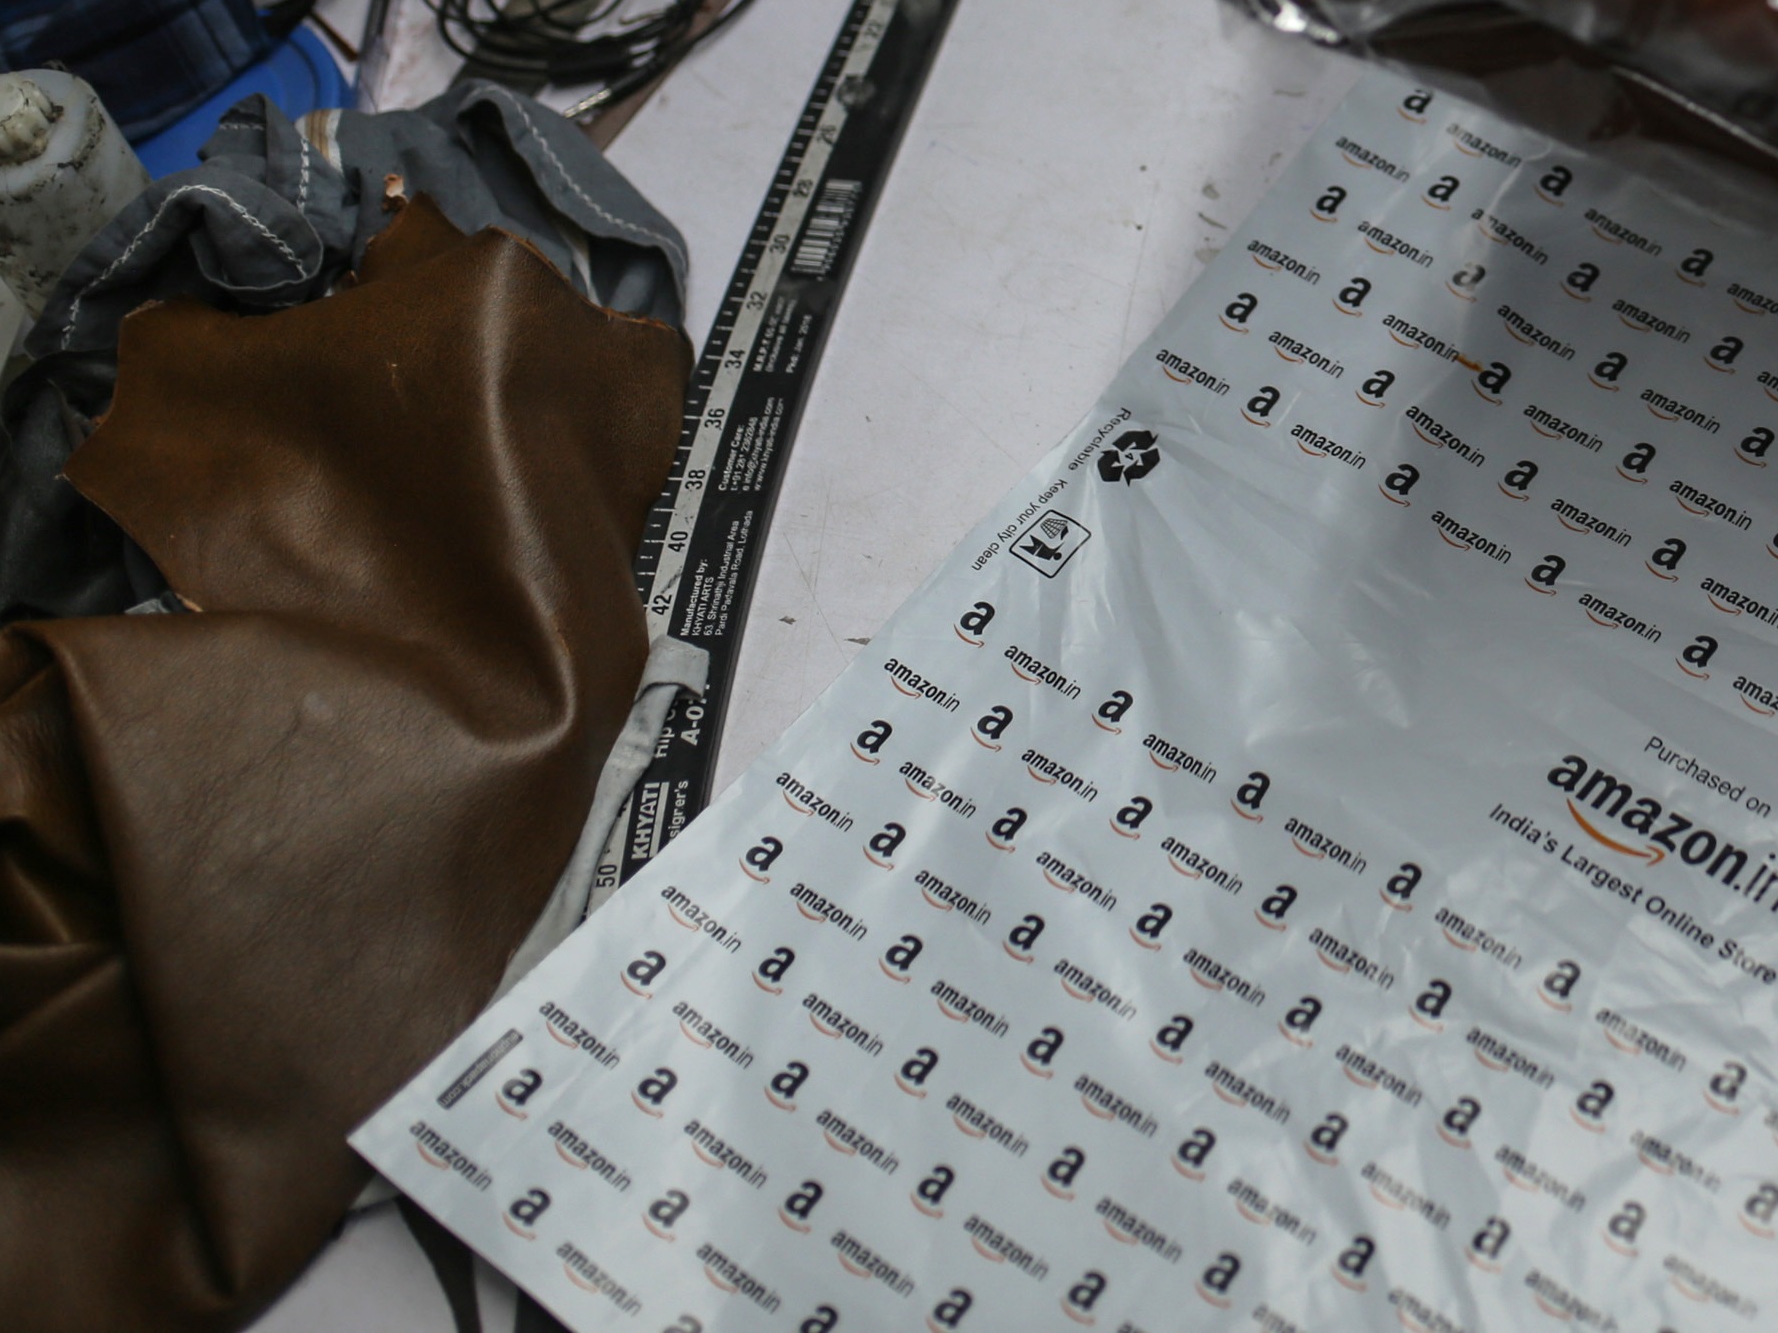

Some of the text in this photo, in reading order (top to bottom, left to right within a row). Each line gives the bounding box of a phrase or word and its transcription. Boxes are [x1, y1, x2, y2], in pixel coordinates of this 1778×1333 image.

[1335, 137, 1410, 181] amazon.in
[793, 178, 814, 198] 28
[1427, 175, 1460, 203] a
[769, 233, 790, 254] 30
[1357, 221, 1433, 268] amazon.in
[1584, 208, 1662, 256] amazon.in
[1247, 240, 1320, 285] amazon.in
[746, 291, 768, 311] 32
[1225, 292, 1258, 324] a
[1612, 299, 1691, 343] amazon.in
[725, 349, 746, 370] 34
[1268, 331, 1344, 378] amazon.in
[1382, 314, 1459, 360] amazon.in
[1497, 305, 1575, 361] amazon.in
[1156, 349, 1230, 396] amazon.in
[1477, 361, 1512, 395] a
[704, 407, 725, 430] 36
[1405, 406, 1485, 467] amazon.in
[1523, 405, 1603, 452] amazon.in
[1640, 389, 1720, 434] amazon.in
[1068, 407, 1132, 471] Recyclable
[1290, 424, 1366, 469] amazon.in
[685, 469, 706, 492] 38
[718, 449, 736, 491] Customer
[1504, 460, 1539, 491] a
[971, 479, 1069, 572] Keep your city clean
[1550, 499, 1632, 547] amazon.in
[1669, 480, 1752, 531] amazon.in
[667, 530, 689, 553] 40
[718, 542, 734, 579] Industrial
[727, 521, 739, 540] Area
[1431, 511, 1511, 564] amazon.in
[1652, 538, 1687, 571] a
[650, 592, 674, 616] 42
[680, 560, 708, 636] Manufactured by:
[692, 577, 714, 636] KHYATI ARTS
[715, 613, 727, 635] Pardi
[960, 601, 995, 636] a
[1578, 593, 1662, 643] amazon.in
[884, 658, 960, 712] amazon.in
[1004, 645, 1081, 700] amazon.in
[1098, 690, 1133, 723] a
[1021, 749, 1098, 802] amazon.in
[1143, 734, 1217, 784] amazon.in
[1643, 736, 1772, 818] Purchased on
[670, 781, 688, 838] signer's
[776, 772, 853, 832] amazon.in
[899, 761, 976, 818] amazon.in
[632, 782, 660, 859] KHYATI
[992, 807, 1027, 841] a
[1284, 817, 1366, 874] amazon.in
[596, 863, 617, 889] 50
[746, 836, 783, 872] a
[1161, 837, 1243, 894] amazon.in
[915, 870, 991, 925] amazon.in
[1036, 852, 1117, 911] amazon.in
[1489, 803, 1778, 985] India's Largest Online Store
[661, 886, 741, 953] amazon.in
[790, 883, 867, 941] amazon.in
[1136, 903, 1173, 939] a
[1435, 908, 1522, 968] amazon.in
[1183, 948, 1265, 1006] amazon.in
[1309, 928, 1394, 989] amazon.in
[930, 980, 1009, 1037] amazon.in
[1053, 959, 1131, 1016] amazon.in
[539, 1002, 619, 1066] amazon.in
[673, 1002, 754, 1069] amazon.in
[802, 993, 883, 1056] amazon.in
[1285, 997, 1323, 1032] a
[770, 1061, 810, 1099] a
[1335, 1045, 1422, 1106] amazon.in
[1466, 1028, 1554, 1087] amazon.in
[1074, 1075, 1157, 1137] amazon.in
[1205, 1062, 1290, 1123] amazon.in
[816, 1110, 898, 1174] amazon.in
[946, 1094, 1028, 1156] amazon.in
[410, 1122, 492, 1190] amazon.in
[547, 1121, 631, 1191] amazon.in
[684, 1120, 767, 1188] amazon.in
[1047, 1146, 1086, 1188] a
[964, 1216, 1048, 1278] amazon.in
[1096, 1198, 1182, 1260] amazon.in
[697, 1244, 780, 1312] amazon.in
